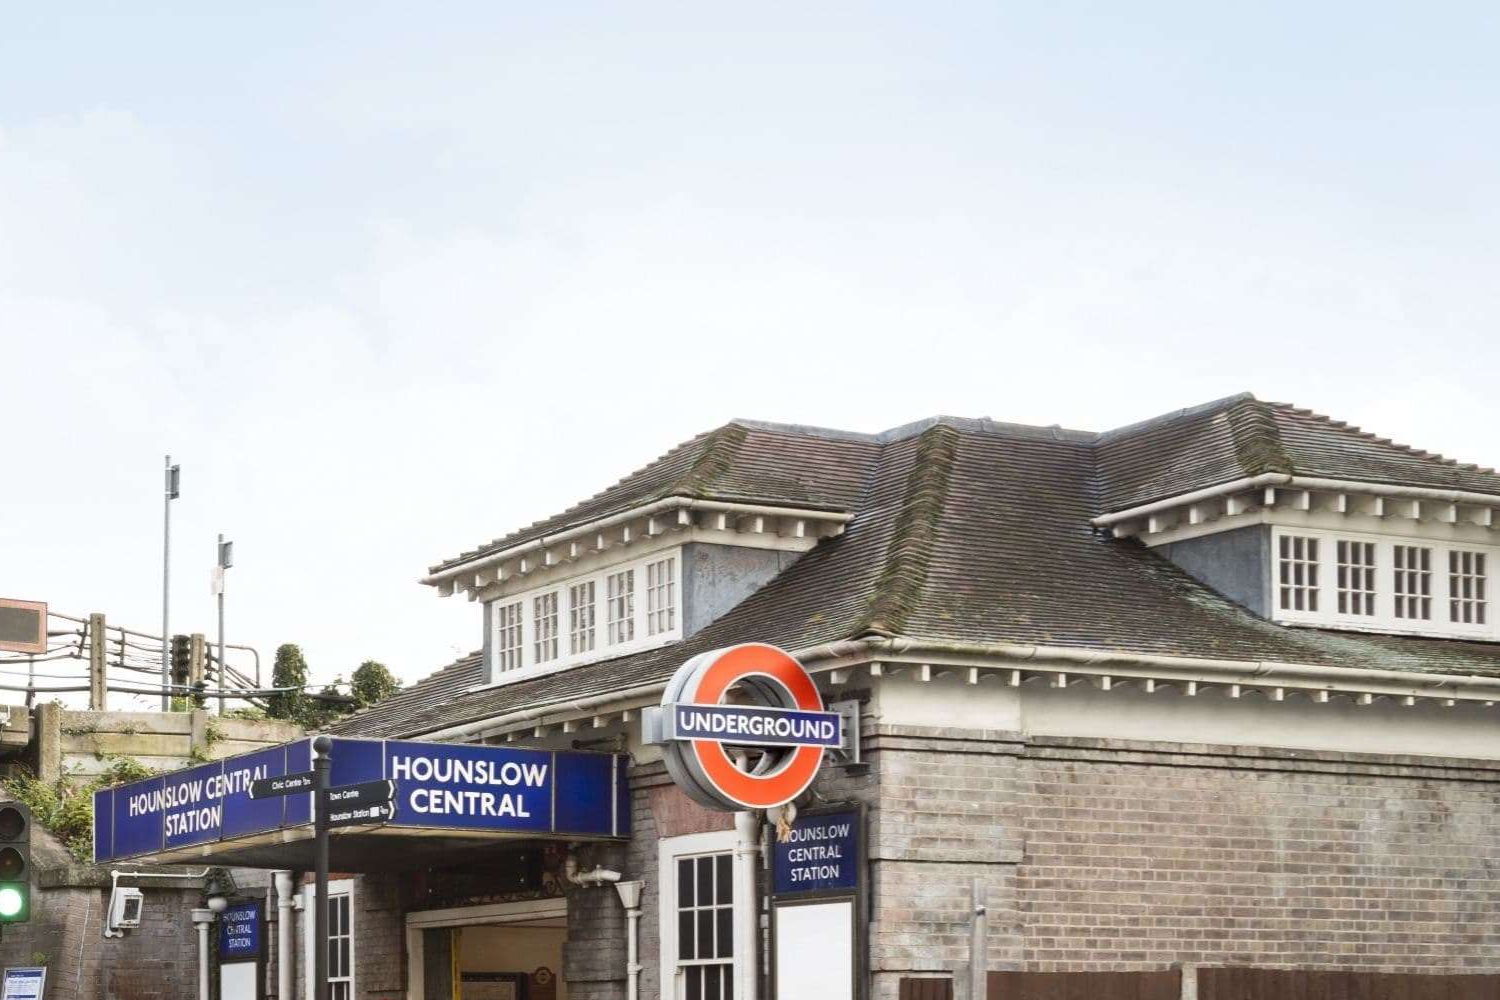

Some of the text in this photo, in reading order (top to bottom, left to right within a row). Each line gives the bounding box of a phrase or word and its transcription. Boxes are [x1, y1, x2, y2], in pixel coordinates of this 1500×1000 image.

[680, 711, 835, 740] UNDERGROUND
[392, 755, 548, 788] HOUNSLOW
[129, 778, 203, 817] HOUNSLOW
[410, 788, 531, 818] CENTRAL
[165, 805, 222, 837] STATION
[352, 809, 370, 818] Station
[785, 823, 850, 843] OUNSLOW
[788, 845, 843, 862] CENTRAL
[790, 865, 840, 882] STATION
[228, 938, 251, 949] STATION
